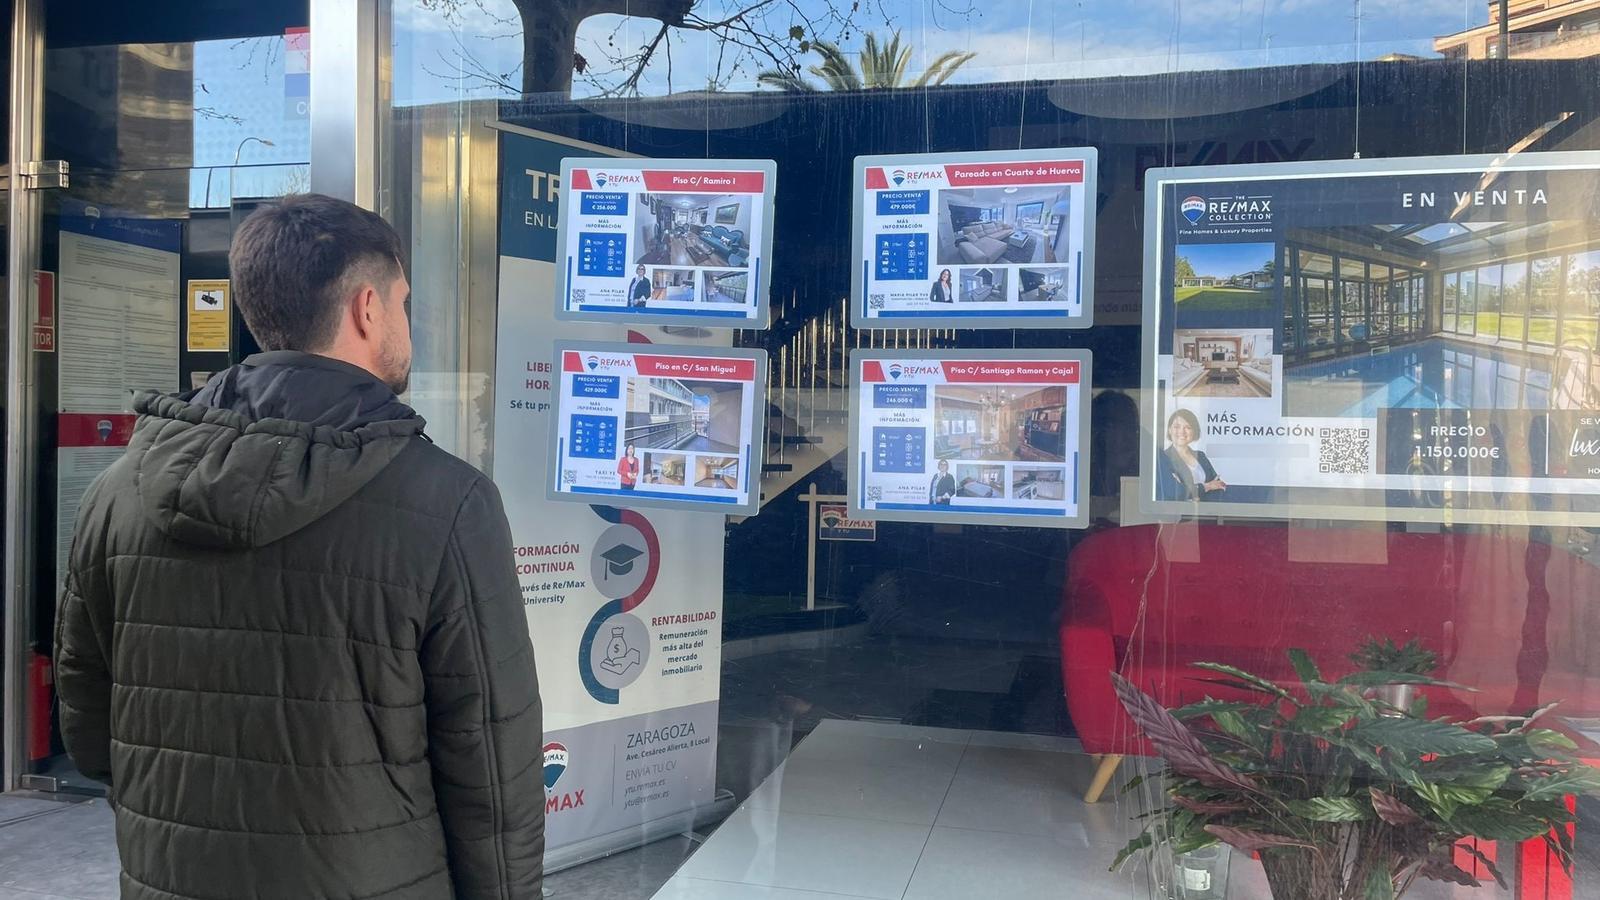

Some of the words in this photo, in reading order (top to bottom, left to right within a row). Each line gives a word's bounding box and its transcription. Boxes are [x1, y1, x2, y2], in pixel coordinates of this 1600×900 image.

[608, 175, 641, 183] RE/MAX
[907, 171, 943, 180] RE/MAX
[954, 169, 990, 179] Pareado
[1004, 169, 1034, 177] Cuarte
[1036, 168, 1048, 176] de
[1049, 167, 1081, 175] Huerva
[525, 169, 560, 202] TR
[672, 176, 689, 184] Piso
[690, 176, 702, 186] C/
[703, 177, 731, 185] Ramiro
[1402, 191, 1436, 208] EN
[1453, 188, 1549, 207] VENTA
[1209, 200, 1271, 214] RE/MAX
[525, 211, 544, 227] EN
[1208, 213, 1272, 221] COLLECTION
[1241, 227, 1273, 235] Properties
[33, 331, 52, 346] TOR
[600, 359, 632, 367] RE/MAX
[655, 363, 671, 371] Piso
[682, 363, 693, 373] C/
[695, 364, 709, 372] San
[710, 365, 737, 375] Miguel
[903, 366, 939, 375] RE/MAX
[950, 366, 966, 375] Piso
[967, 366, 979, 376] C/
[980, 366, 1015, 377] Santiago
[1017, 367, 1044, 375] Ramon
[1045, 368, 1051, 377] y
[1052, 367, 1074, 378] Cajal
[525, 379, 550, 390] HOR
[510, 399, 522, 409] Sé
[525, 401, 536, 410] tu
[1206, 410, 1238, 424] MÁS
[1580, 417, 1593, 425] SE
[1206, 424, 1315, 437] INFORMACIÓN
[1430, 425, 1487, 438] PRECIO
[1414, 445, 1500, 459] 1.150.000€
[1587, 467, 1600, 475] HO
[513, 541, 580, 557] FORMACIÓN
[516, 560, 576, 575] CONTINUA
[520, 583, 540, 593] avés
[541, 582, 551, 591] de
[552, 580, 586, 590] Re/Max
[523, 593, 566, 606] University
[651, 610, 718, 627] RENTABILIDAD
[658, 628, 709, 642] Remuneración
[662, 644, 678, 652] más
[679, 641, 694, 651] alta
[695, 640, 705, 650] del
[667, 653, 699, 664] mercado
[661, 664, 704, 677] inmobiliario
[626, 721, 697, 749] ZARAGOZA
[641, 746, 667, 758] Cesáreo
[695, 735, 711, 746] Local
[652, 762, 664, 776] TU
[665, 759, 678, 772] CV
[545, 788, 586, 815] MAX
